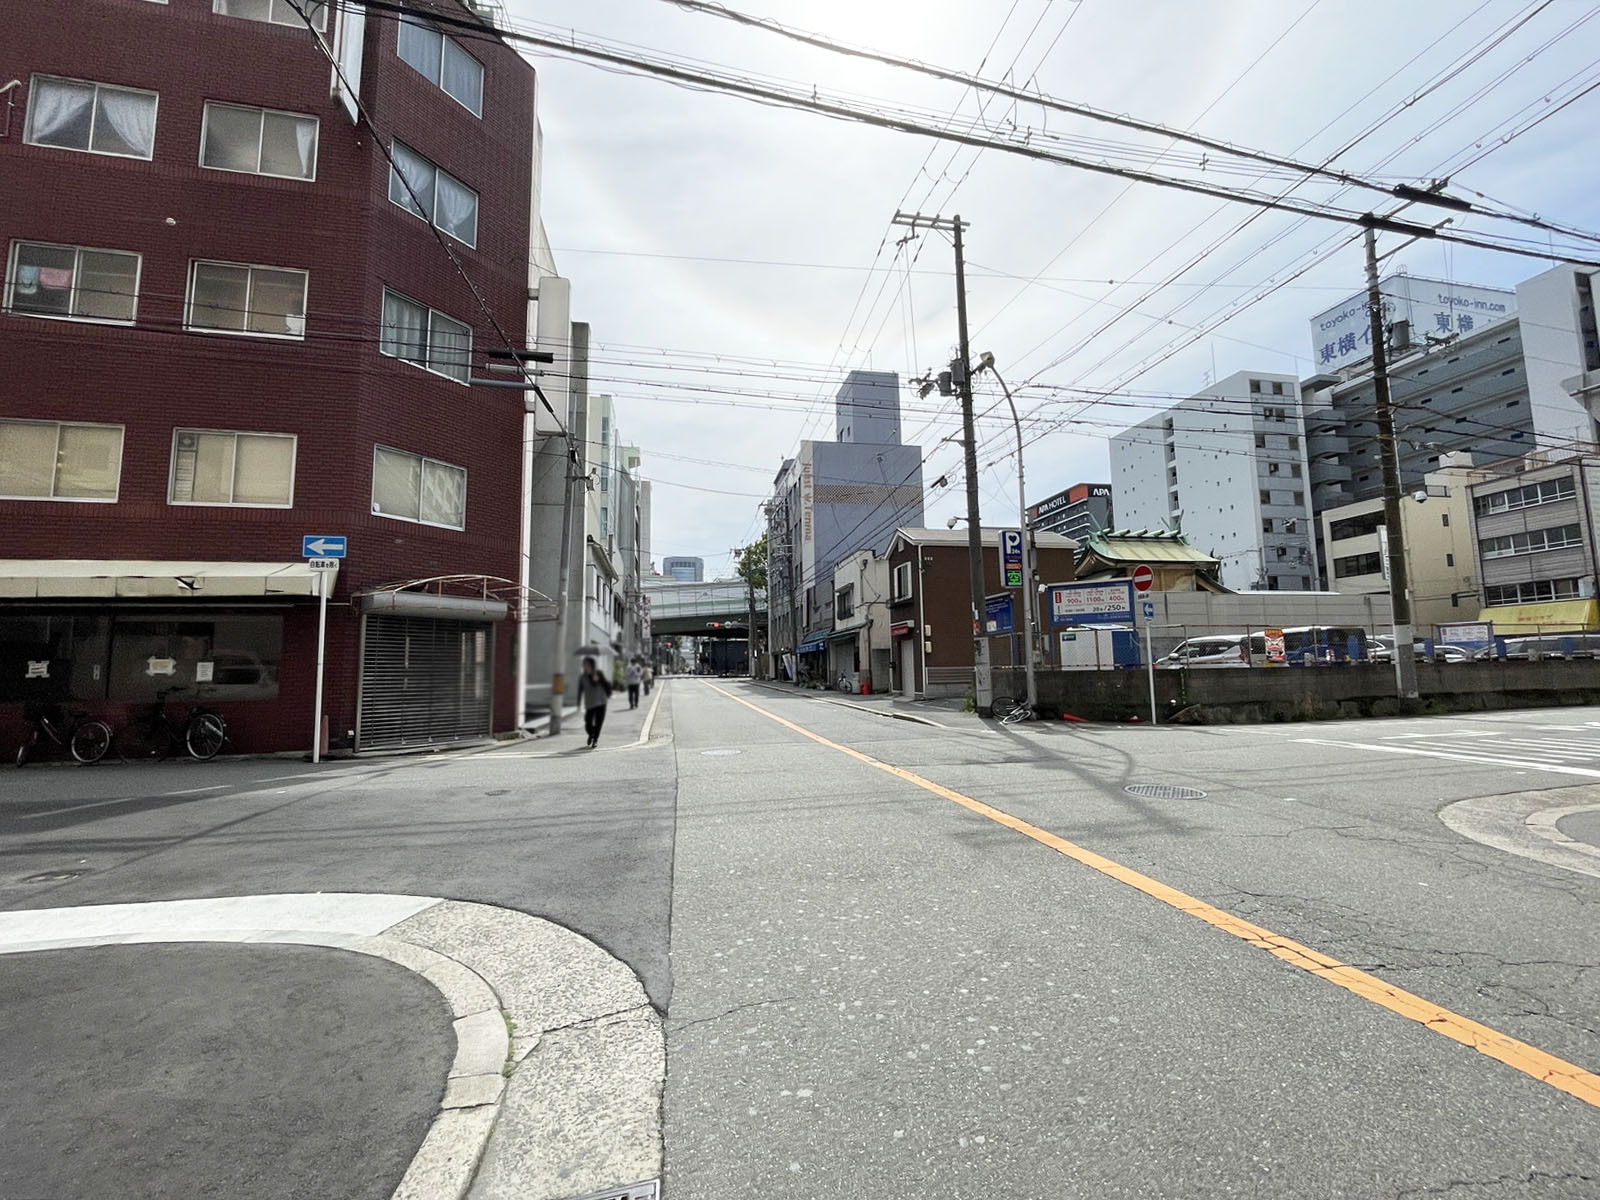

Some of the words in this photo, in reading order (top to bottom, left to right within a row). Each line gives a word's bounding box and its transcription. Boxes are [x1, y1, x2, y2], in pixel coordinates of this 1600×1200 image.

[1438, 293, 1506, 312] toyoko-inn.com
[1093, 488, 1110, 496] APA
[1038, 503, 1049, 514] APA
[1049, 496, 1067, 509] HOTEL
